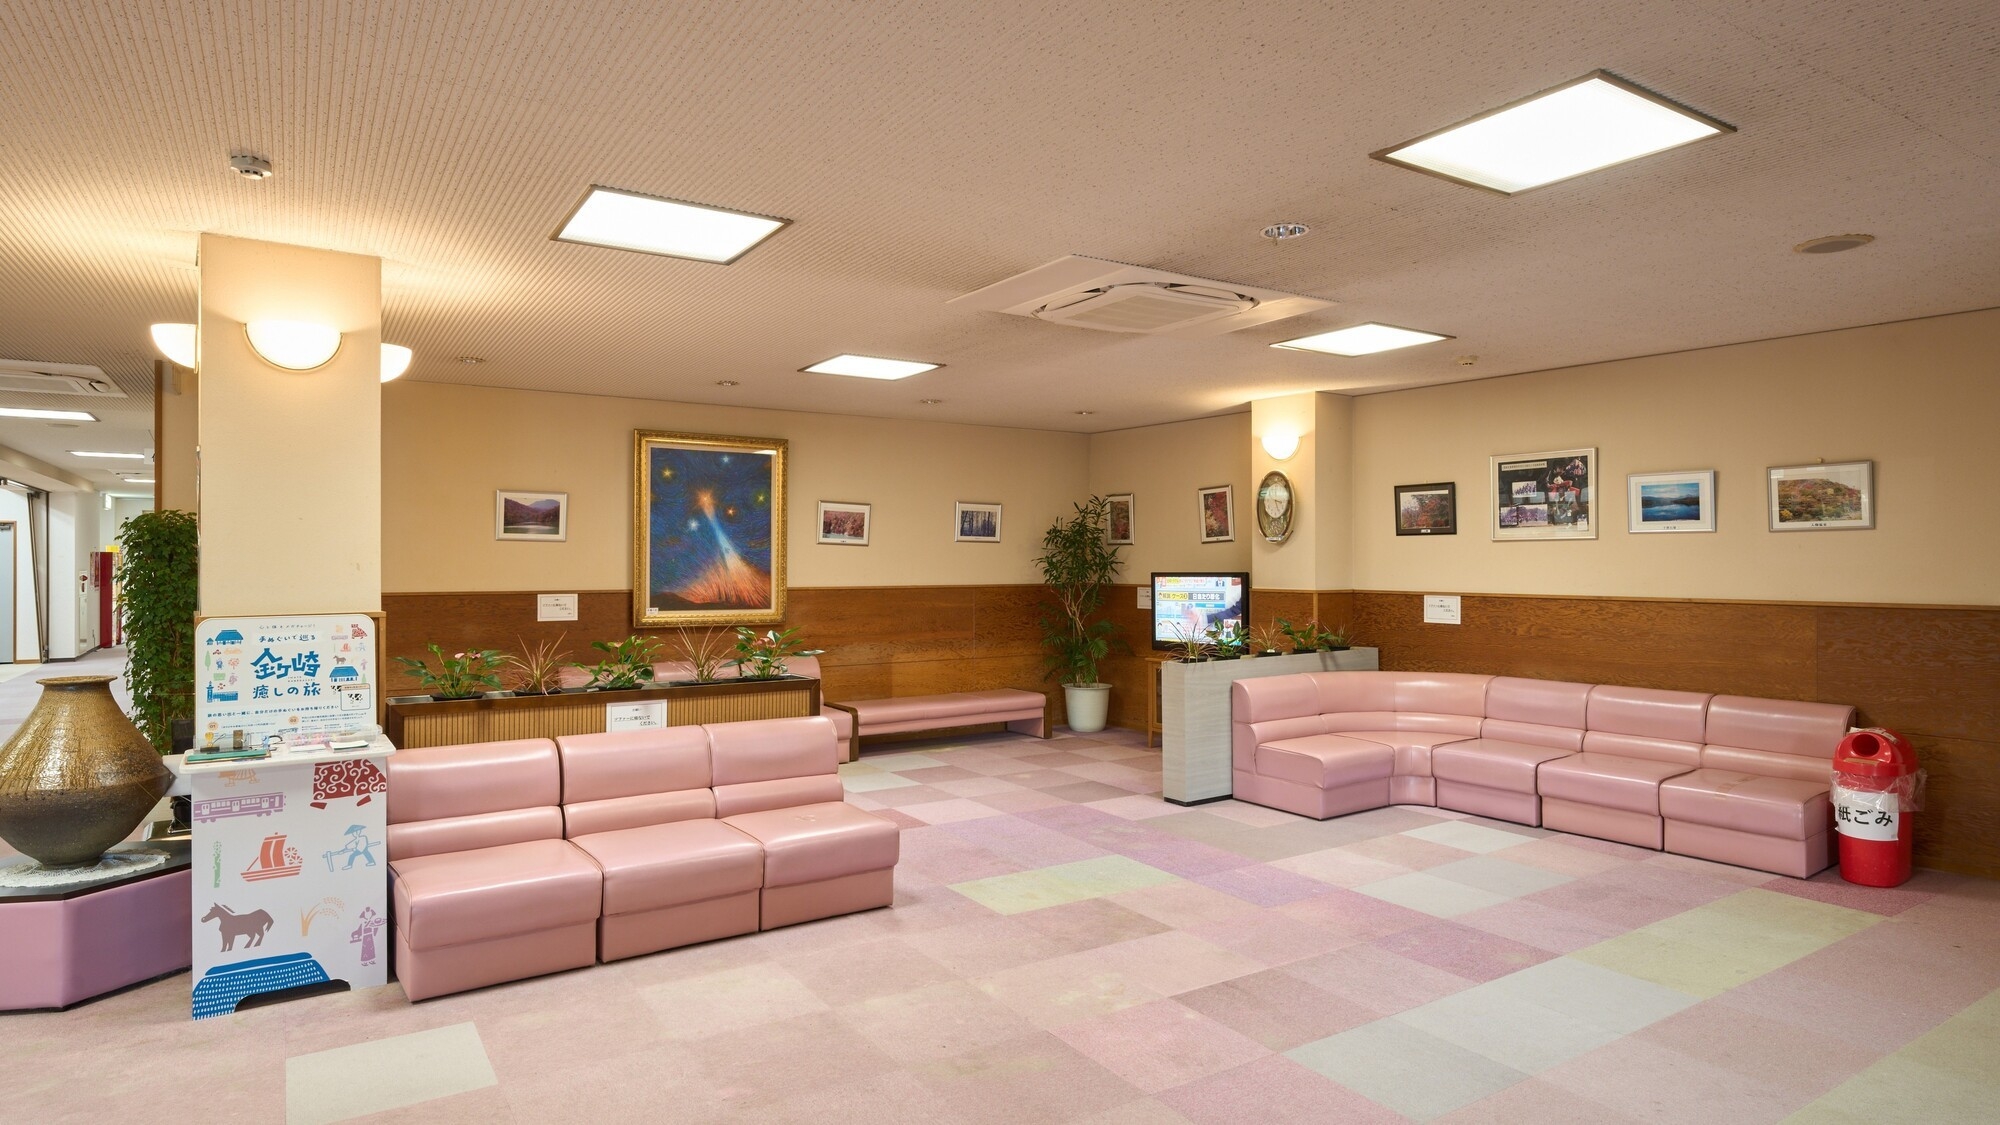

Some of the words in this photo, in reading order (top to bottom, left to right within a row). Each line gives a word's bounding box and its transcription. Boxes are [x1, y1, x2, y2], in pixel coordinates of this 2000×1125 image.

[259, 634, 316, 642] 手ぬぐいで巡る
[252, 682, 321, 699] 癒しの旅
[1838, 803, 1893, 827] 紙ごみ
